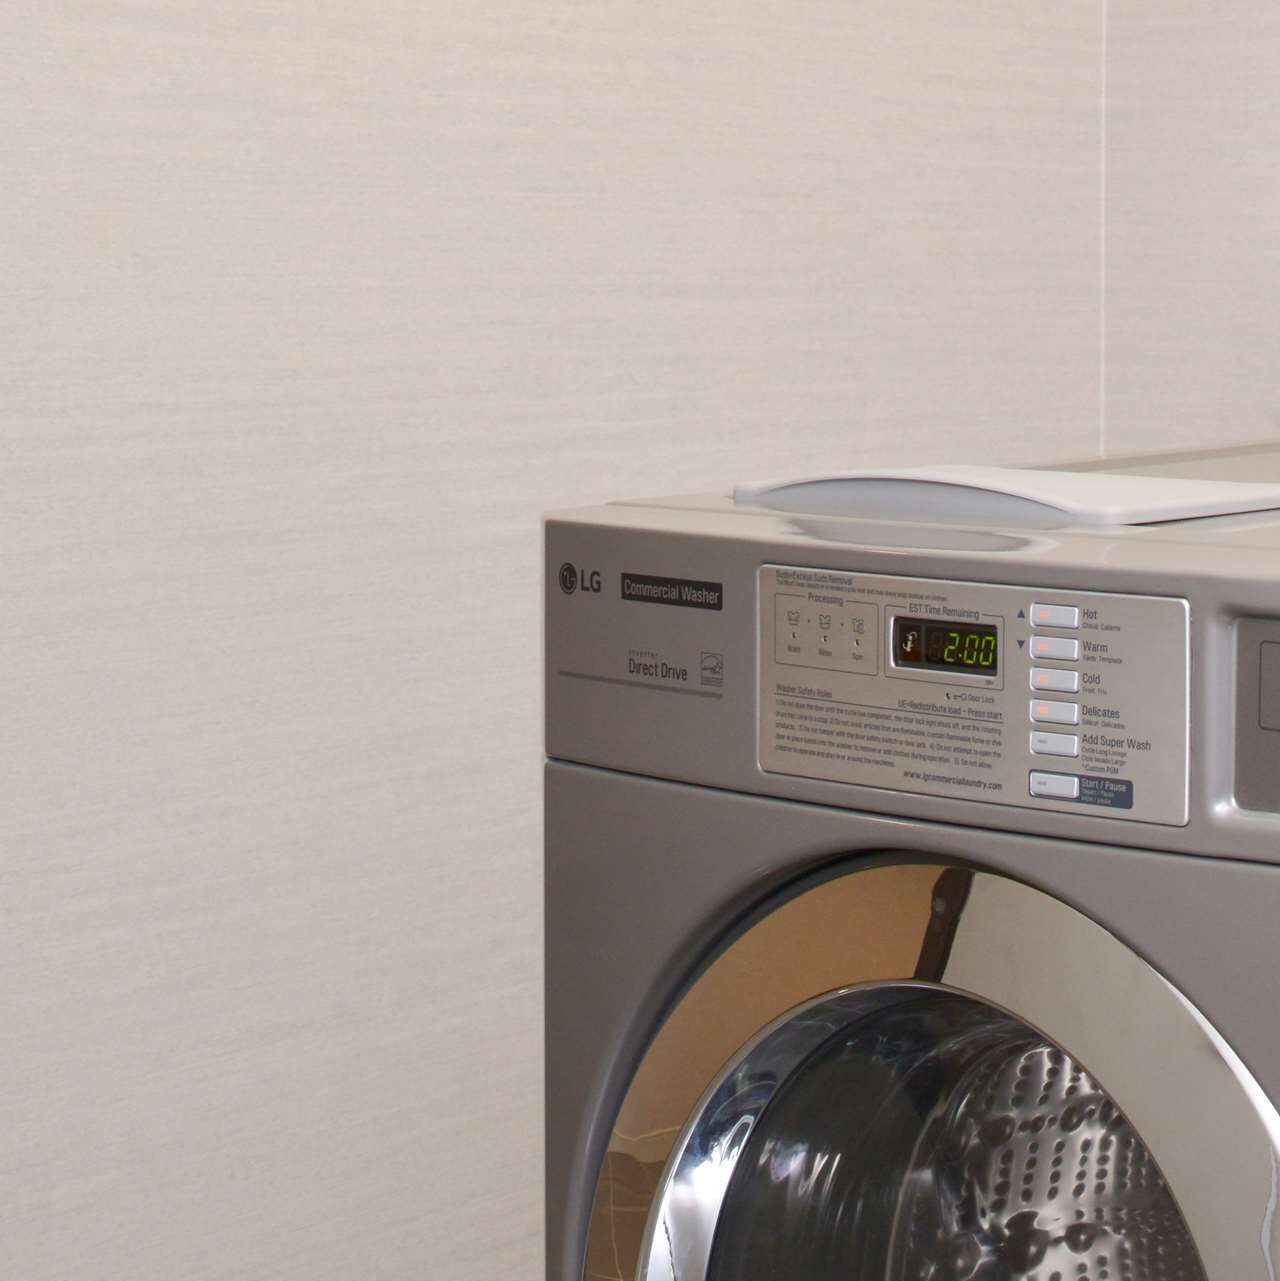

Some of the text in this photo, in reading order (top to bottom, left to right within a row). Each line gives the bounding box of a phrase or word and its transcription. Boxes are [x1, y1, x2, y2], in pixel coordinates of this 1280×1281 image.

[580, 569, 601, 593] LG
[624, 578, 720, 605] Commercial Washer
[807, 592, 844, 607] Processing
[925, 604, 941, 616] Time
[942, 606, 979, 620] Remaining
[1082, 608, 1098, 620] Hot
[1082, 640, 1109, 653] Warm
[628, 657, 688, 681] Direct Drive
[1082, 672, 1101, 685] Cold
[1082, 705, 1121, 719] Delicates
[1081, 734, 1152, 751] Add Super Wash
